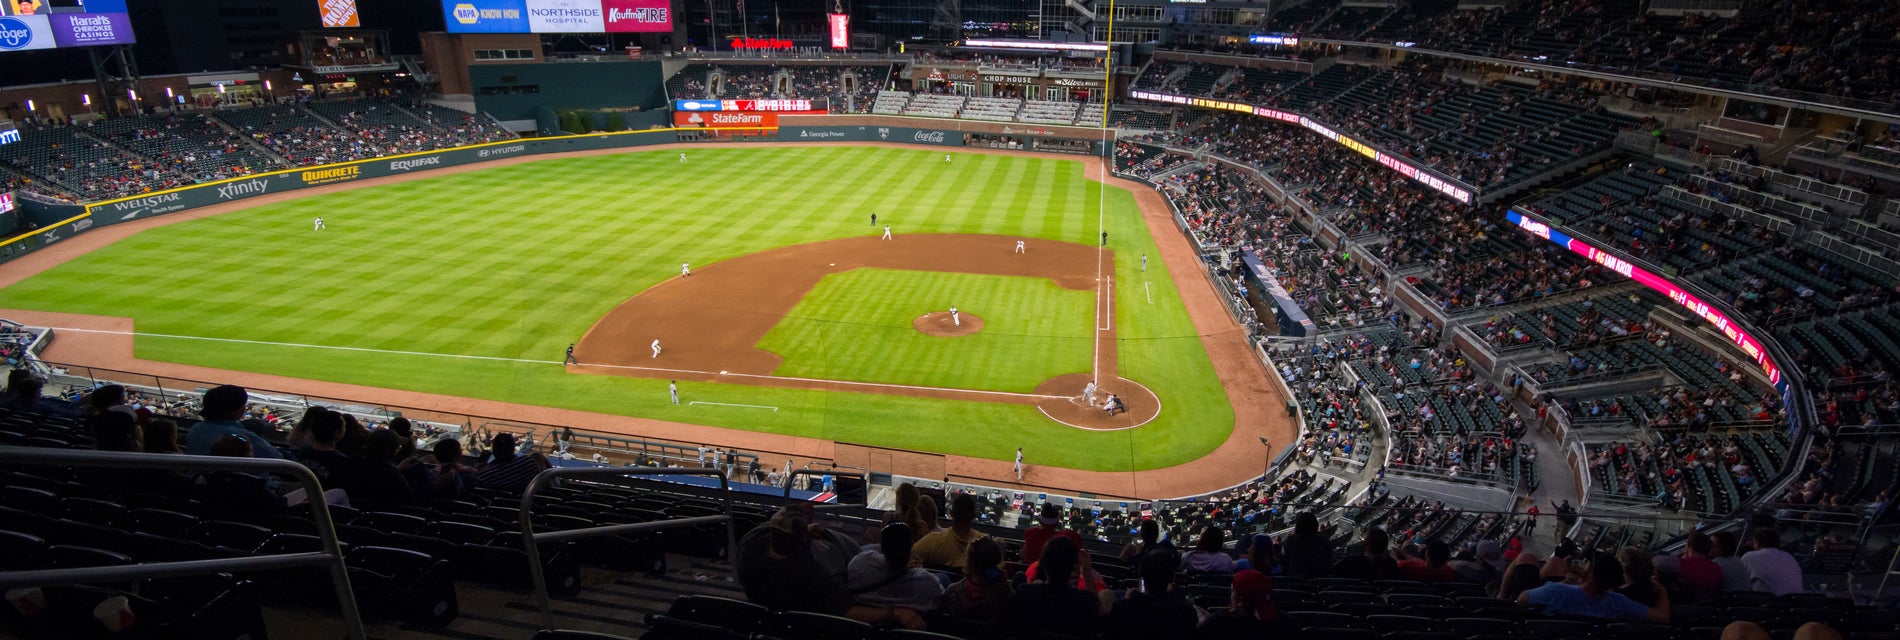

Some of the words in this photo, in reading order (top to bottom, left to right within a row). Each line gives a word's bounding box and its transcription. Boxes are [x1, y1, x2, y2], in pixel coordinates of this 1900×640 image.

[457, 8, 476, 18] NAPA
[479, 9, 502, 19] KNOW
[503, 9, 520, 19] HOW
[531, 8, 600, 17] NORTHSIDE
[638, 8, 667, 22] TIRE
[73, 25, 113, 33] CHEROKEE
[75, 31, 115, 39] CASINOS
[1206, 100, 1216, 108] THE
[1216, 101, 1228, 110] LAW
[1228, 102, 1235, 110] IN
[491, 145, 525, 155] HYUNDAI
[390, 156, 441, 171] EQUIFAX
[302, 166, 359, 182] QUIKRETE
[217, 178, 268, 200] xfinity
[1419, 171, 1430, 185] SEAT
[1429, 176, 1442, 191] BELTS
[1442, 182, 1455, 196] SAVE
[1455, 188, 1469, 203] LIVES
[114, 192, 181, 212] WELLSTAR
[1595, 251, 1605, 264] 46
[1604, 254, 1617, 270] IAN
[1615, 259, 1632, 278] KROL
